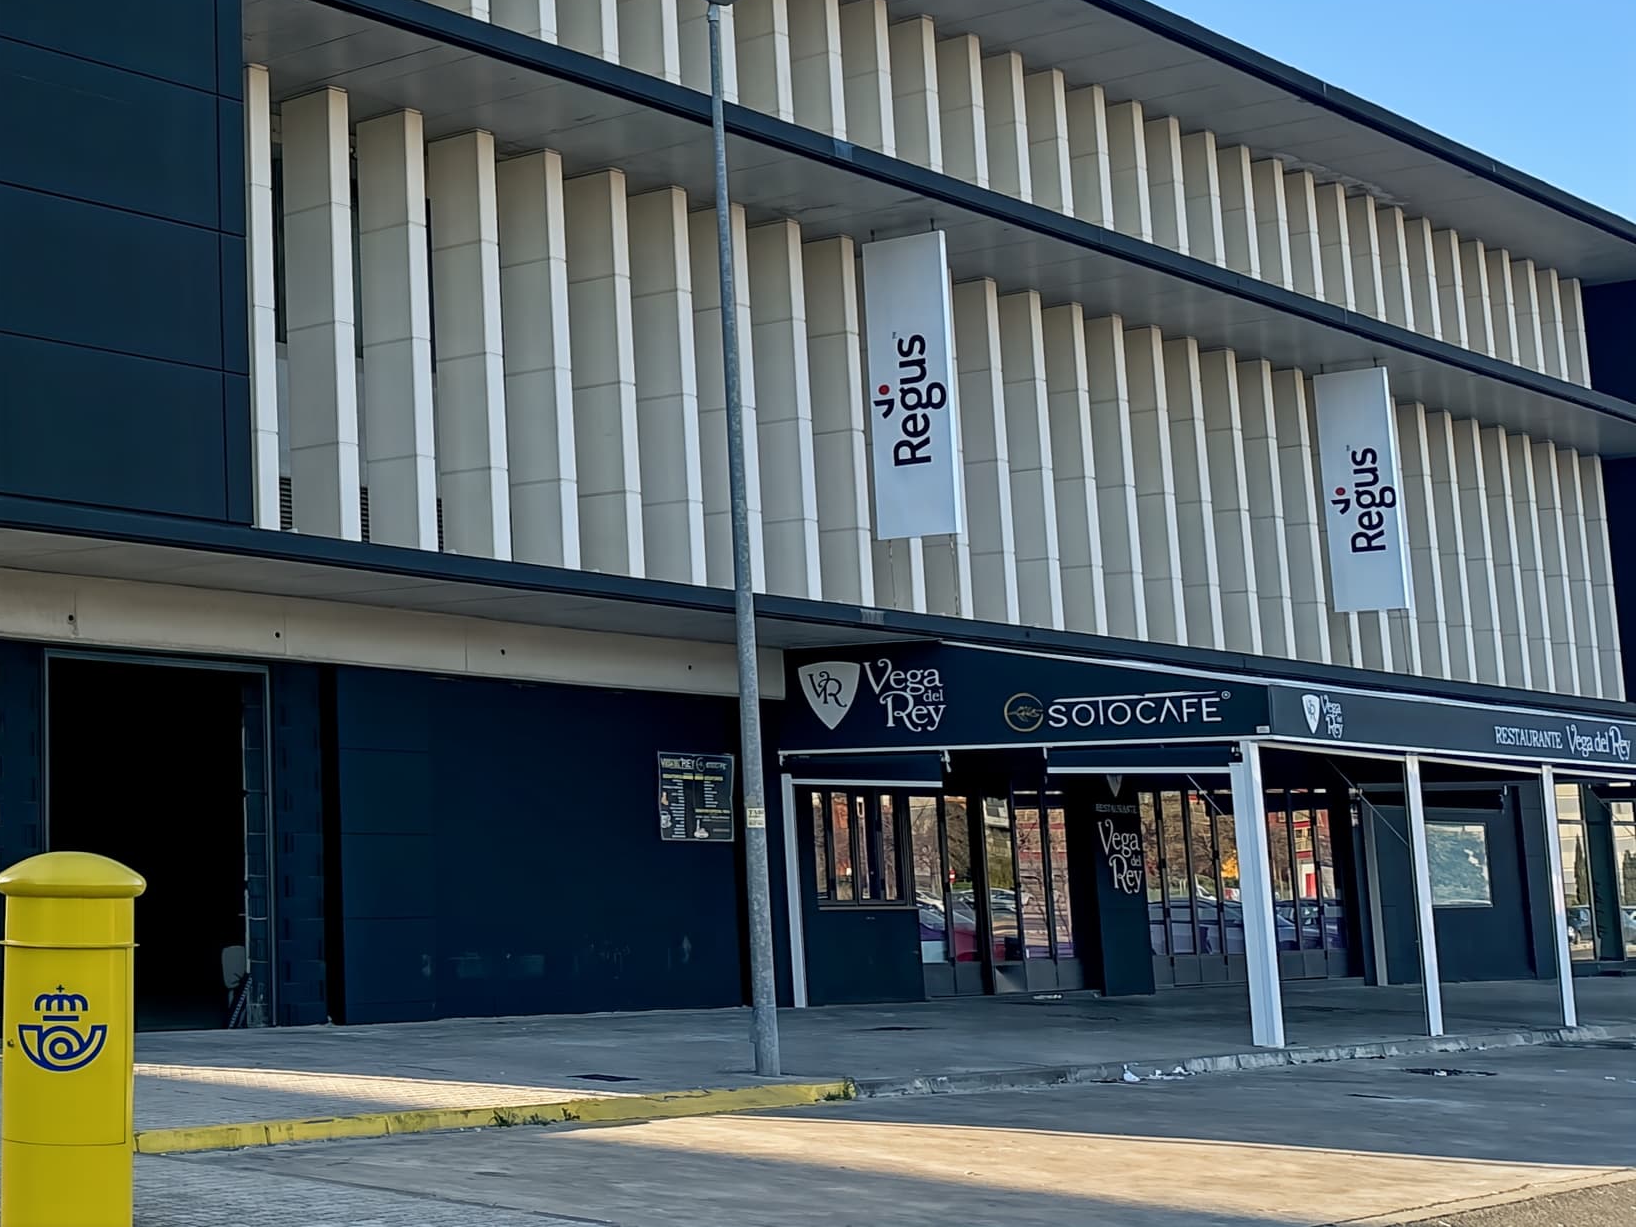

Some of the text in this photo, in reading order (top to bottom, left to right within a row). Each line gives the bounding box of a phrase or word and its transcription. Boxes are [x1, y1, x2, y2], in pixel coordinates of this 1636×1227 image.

[892, 333, 947, 468] Regus
[1350, 446, 1397, 554] Regus
[863, 658, 944, 696] Vega
[922, 689, 945, 703] del
[879, 690, 947, 732] Rey
[1493, 724, 1631, 761] RESTAURANTE Vega del Rey
[1097, 818, 1141, 858] Vega
[1108, 853, 1143, 895] Rey
